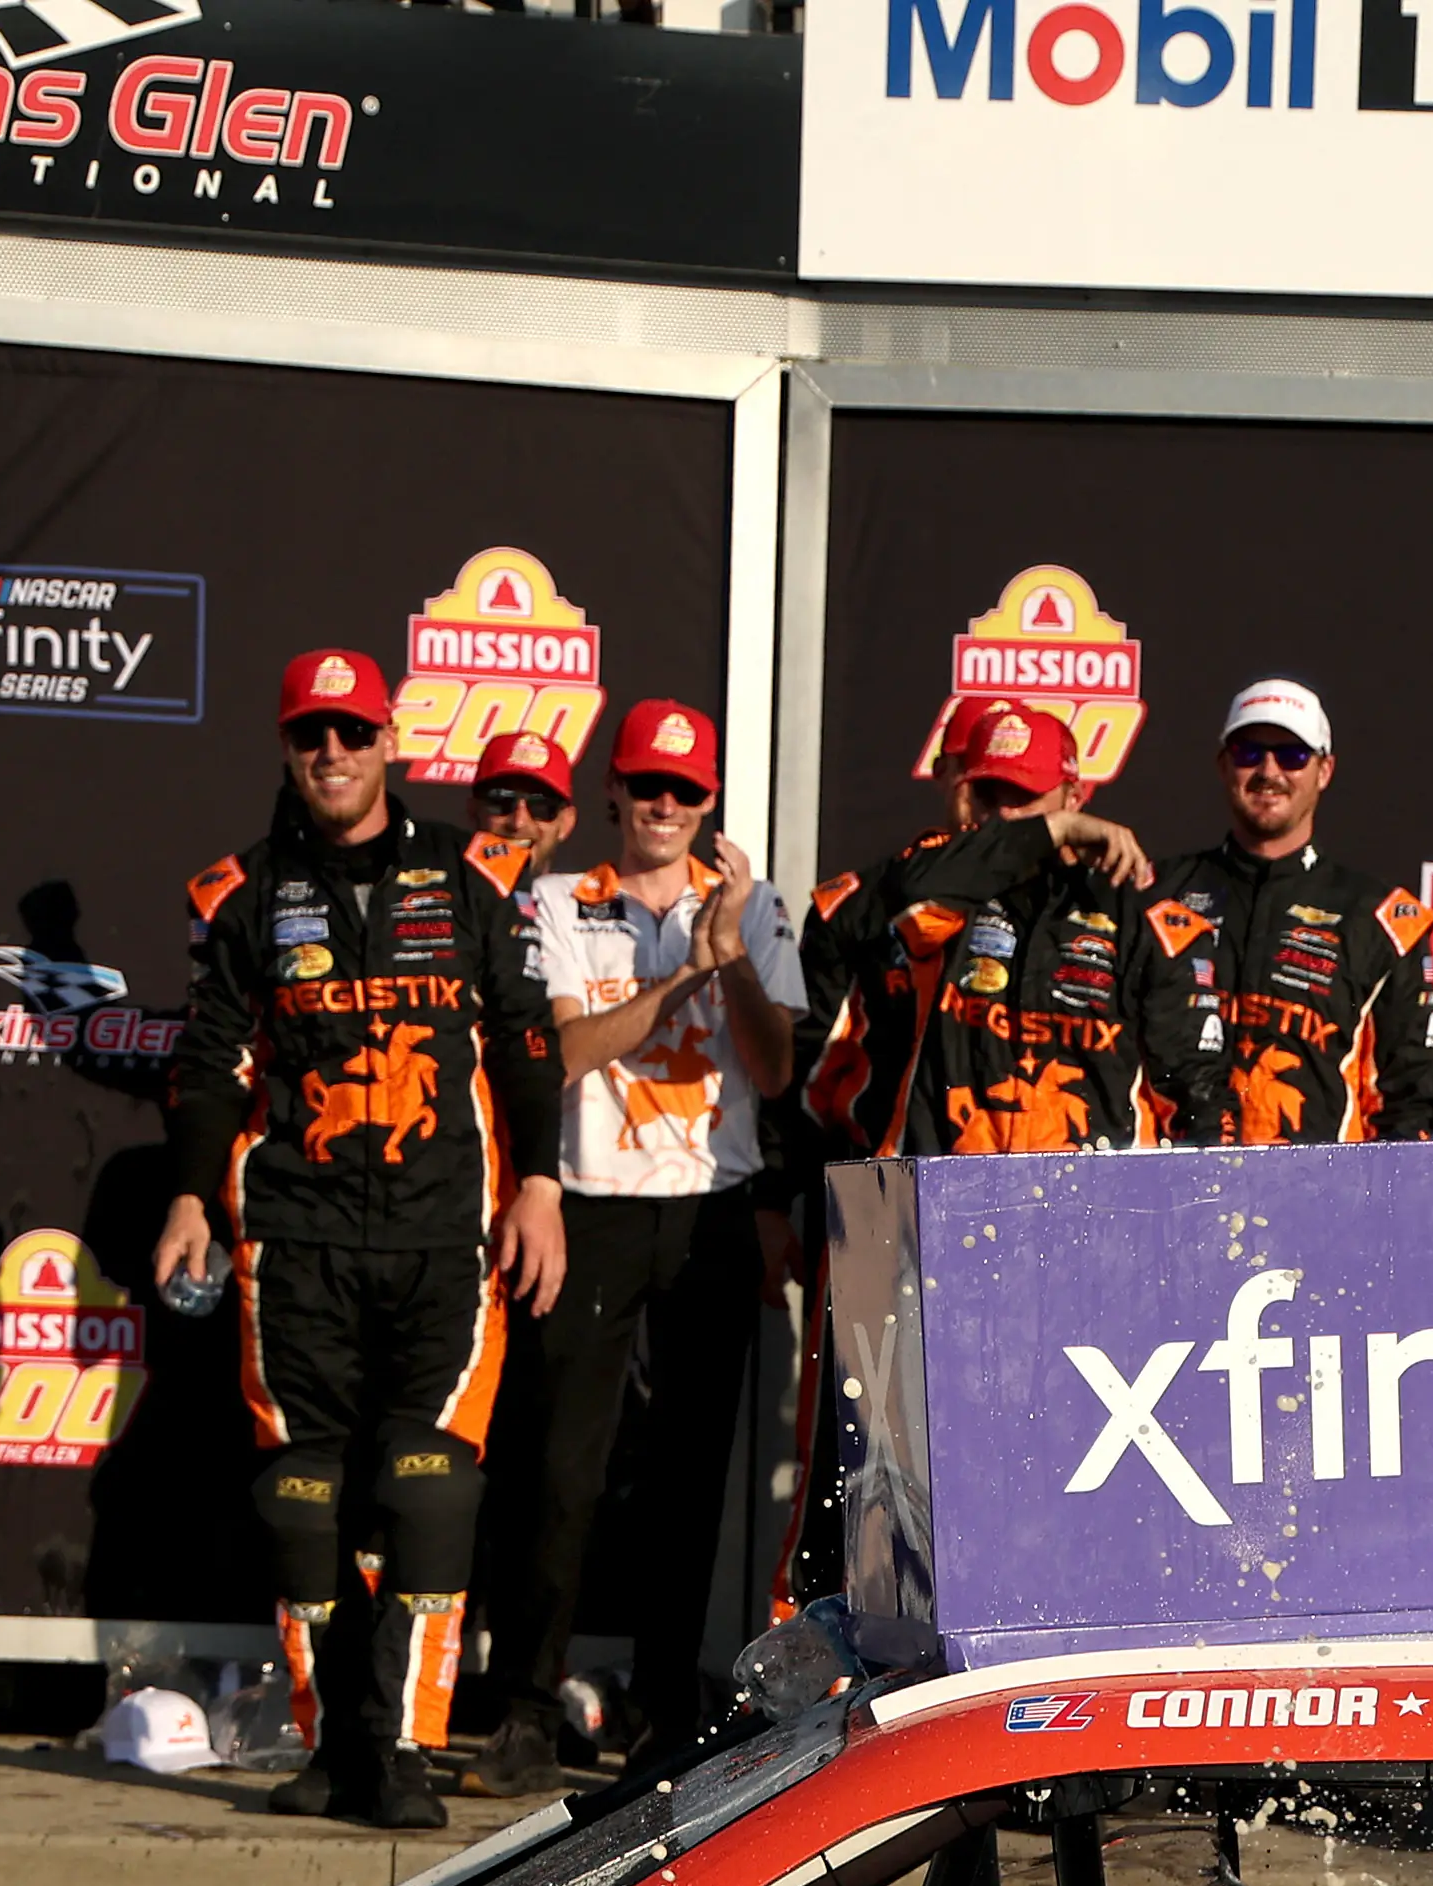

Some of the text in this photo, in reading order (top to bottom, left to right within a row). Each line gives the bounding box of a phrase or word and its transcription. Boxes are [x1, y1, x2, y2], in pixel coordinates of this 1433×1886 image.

[885, 0, 1315, 108] Mobil
[106, 55, 354, 172] Glen
[9, 578, 117, 610] NASCAR
[1127, 1686, 1379, 1730] CONNOR
